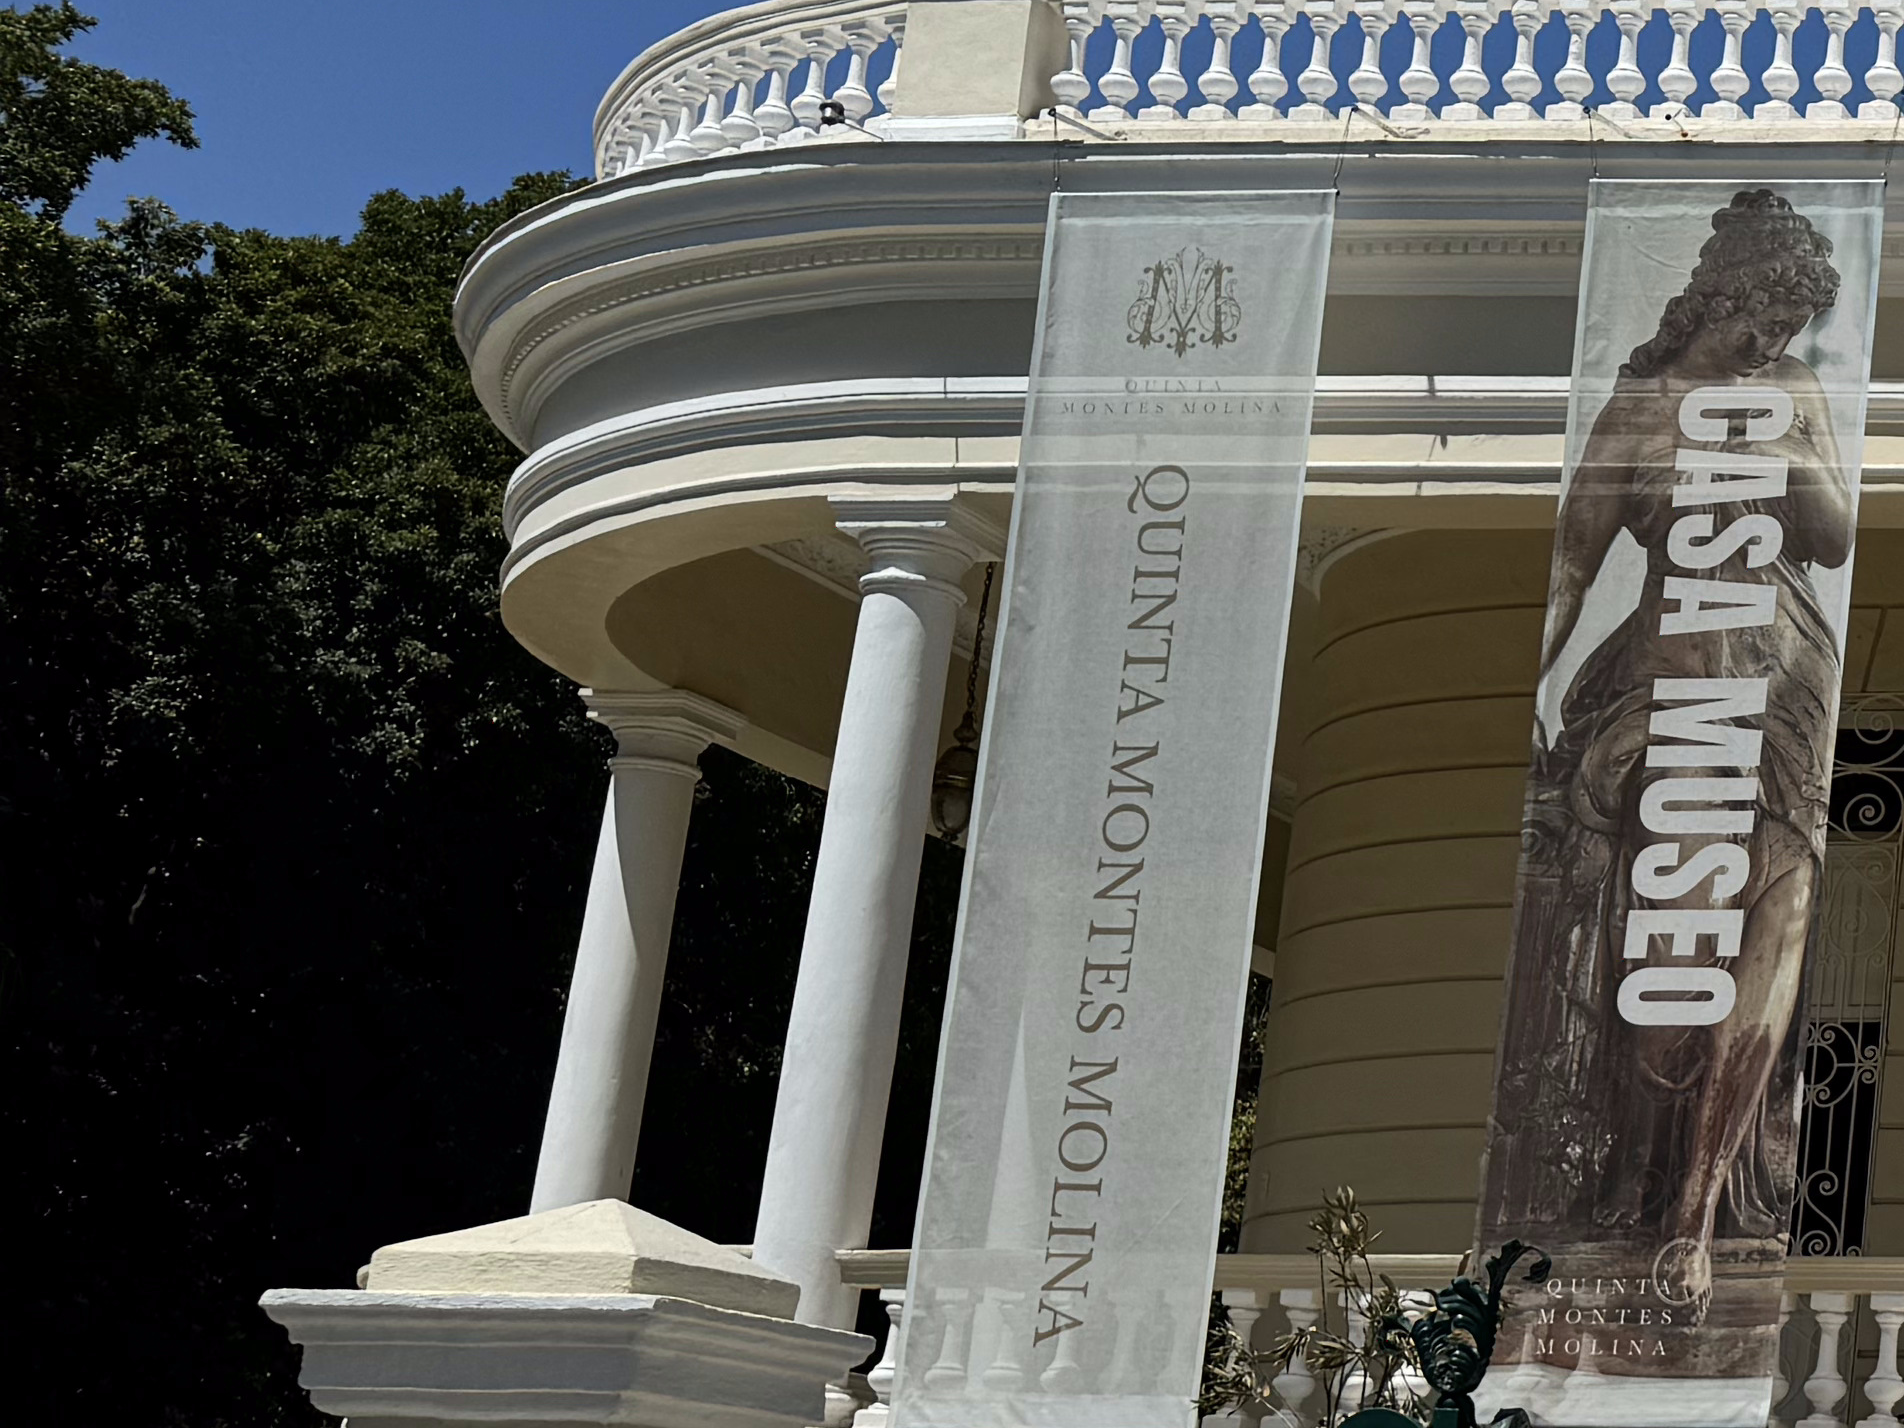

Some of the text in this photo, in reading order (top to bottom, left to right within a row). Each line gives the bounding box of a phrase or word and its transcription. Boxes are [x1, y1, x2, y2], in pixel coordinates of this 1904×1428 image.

[1125, 380, 1223, 396] QUINTA
[1061, 401, 1282, 415] MONTES MOLINA
[1616, 385, 1795, 1026] CASA MUSEO
[1032, 464, 1190, 1349] QUINTA MONTES MOLINA
[1546, 1278, 1672, 1299] QUINTA
[1537, 1308, 1673, 1326] MONTES
[1535, 1338, 1667, 1356] MOLINA
